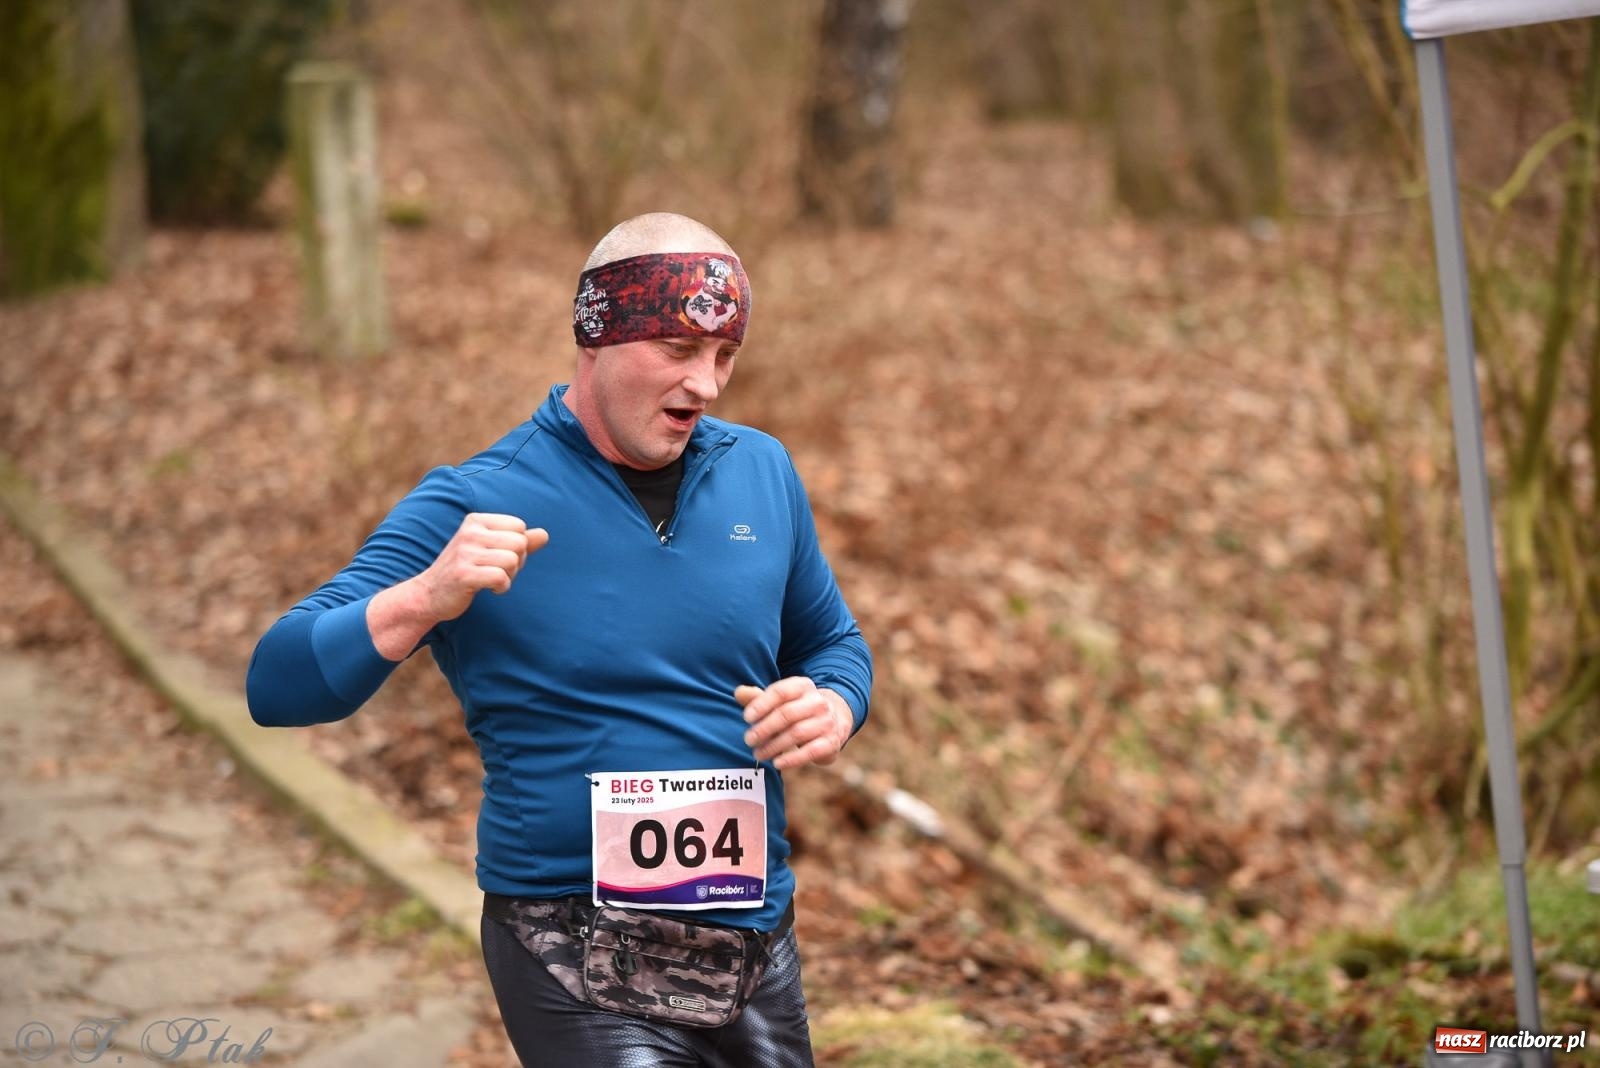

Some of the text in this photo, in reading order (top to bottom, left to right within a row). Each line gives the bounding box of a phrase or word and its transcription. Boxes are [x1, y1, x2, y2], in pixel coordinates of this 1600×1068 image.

[588, 289, 607, 301] RUN
[610, 774, 753, 794] BIEG Twardziela
[620, 797, 636, 806] luty
[636, 796, 655, 804] 2025
[629, 817, 744, 870] 064
[709, 884, 745, 896] Racibórz
